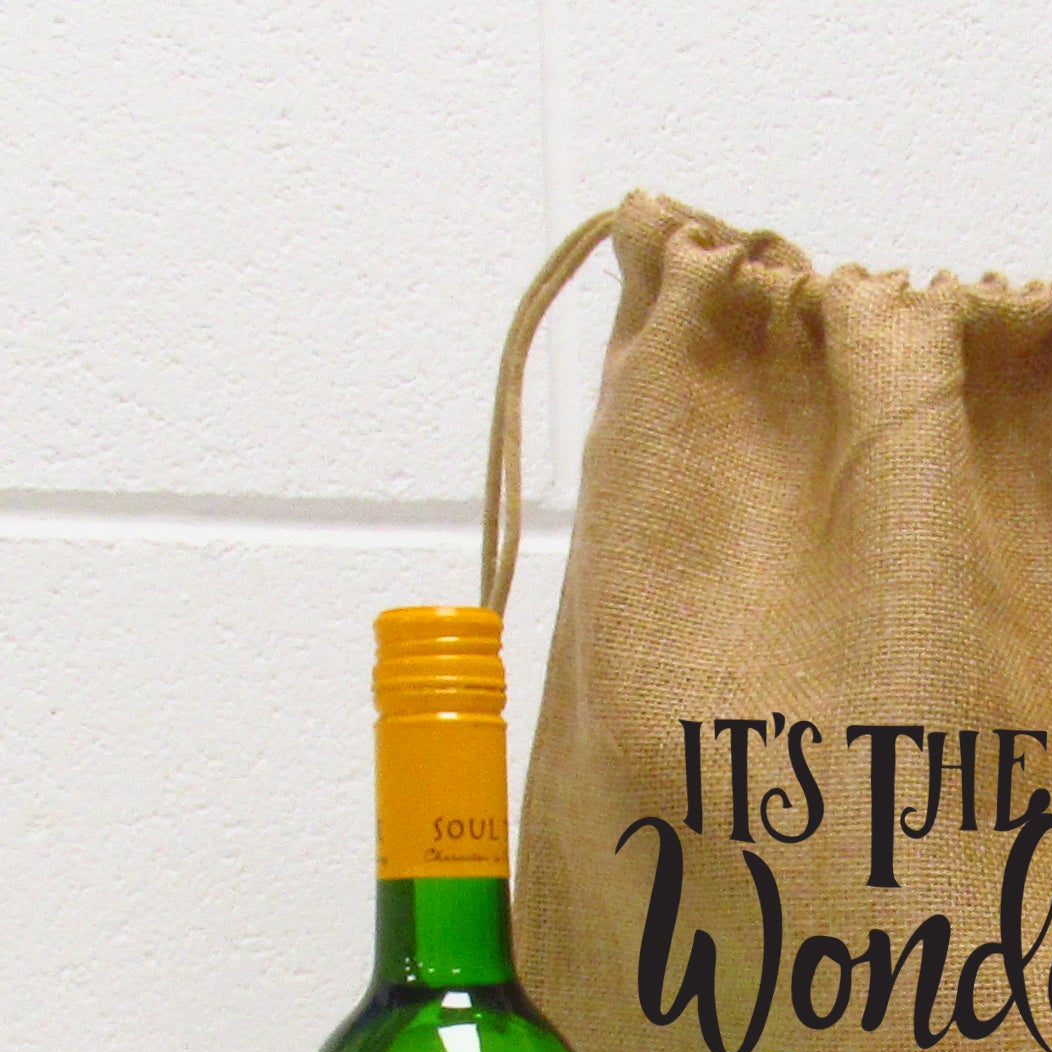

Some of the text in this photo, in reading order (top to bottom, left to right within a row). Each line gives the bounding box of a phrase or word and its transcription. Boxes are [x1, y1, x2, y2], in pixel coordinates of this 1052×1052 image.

[434, 817, 499, 841] SOUL
[679, 712, 824, 843] IT'S
[847, 725, 1051, 887] THE
